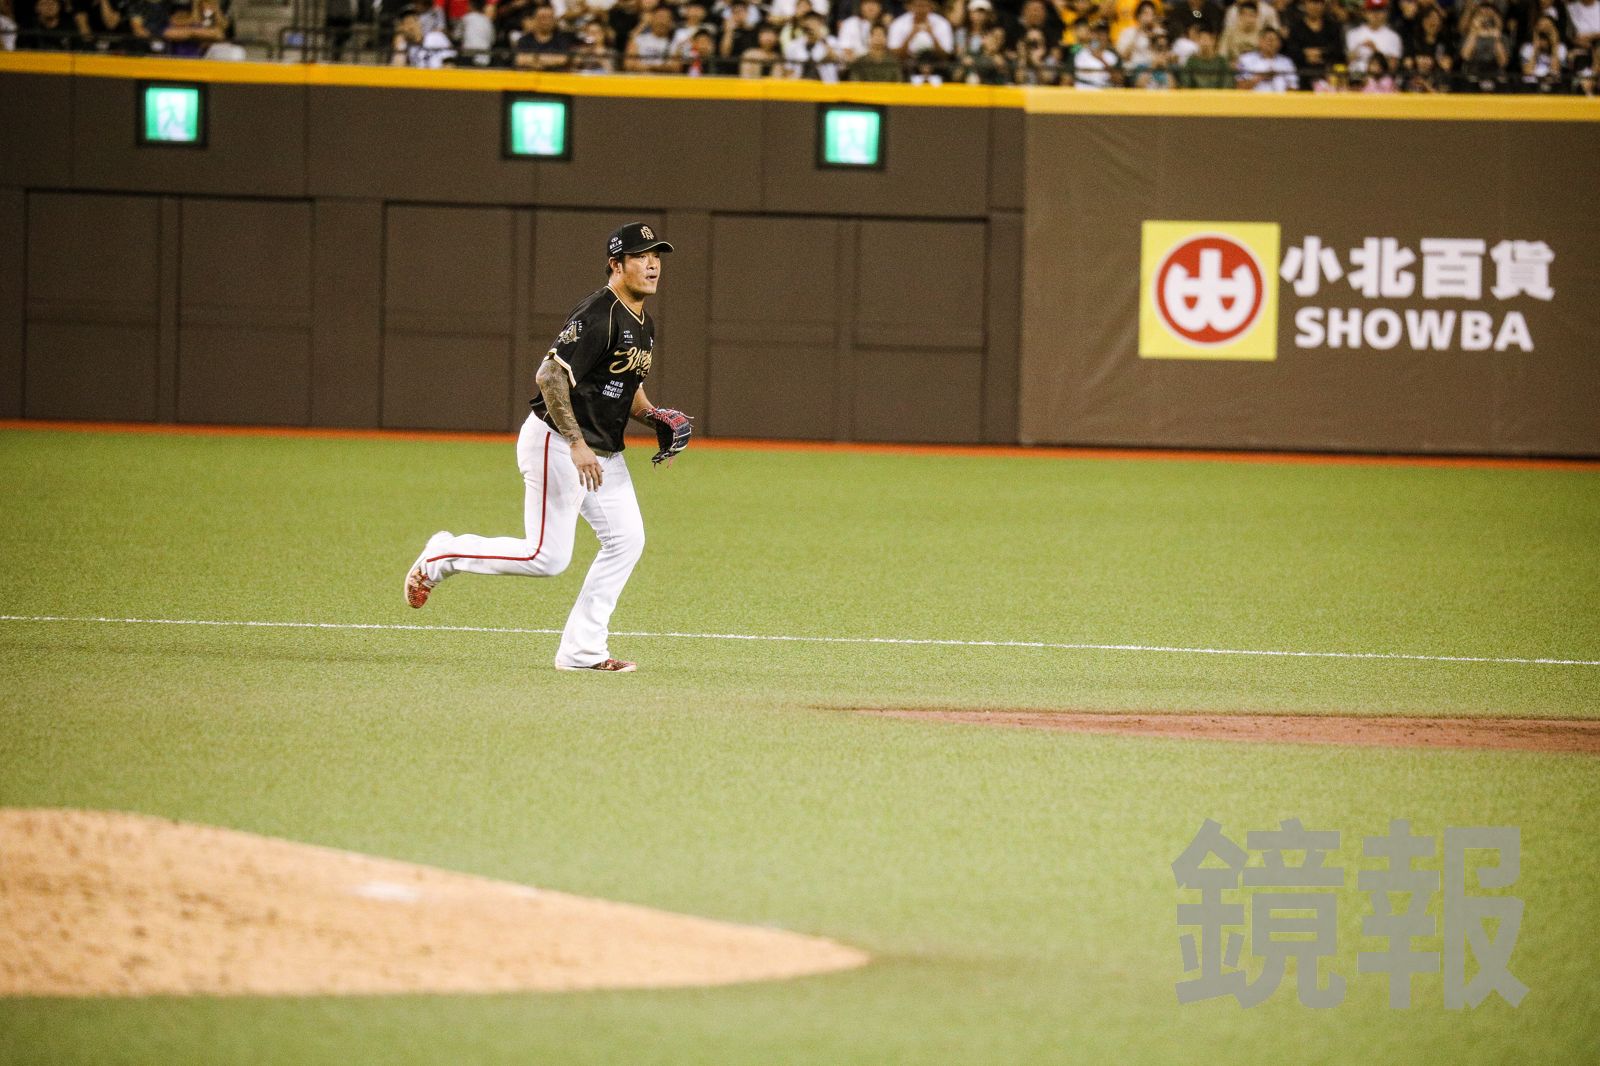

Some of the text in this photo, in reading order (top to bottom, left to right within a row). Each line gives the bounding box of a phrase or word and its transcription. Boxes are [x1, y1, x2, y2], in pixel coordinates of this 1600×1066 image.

[1279, 235, 1555, 301] 小北百貨
[1294, 306, 1534, 352] SHOWBA
